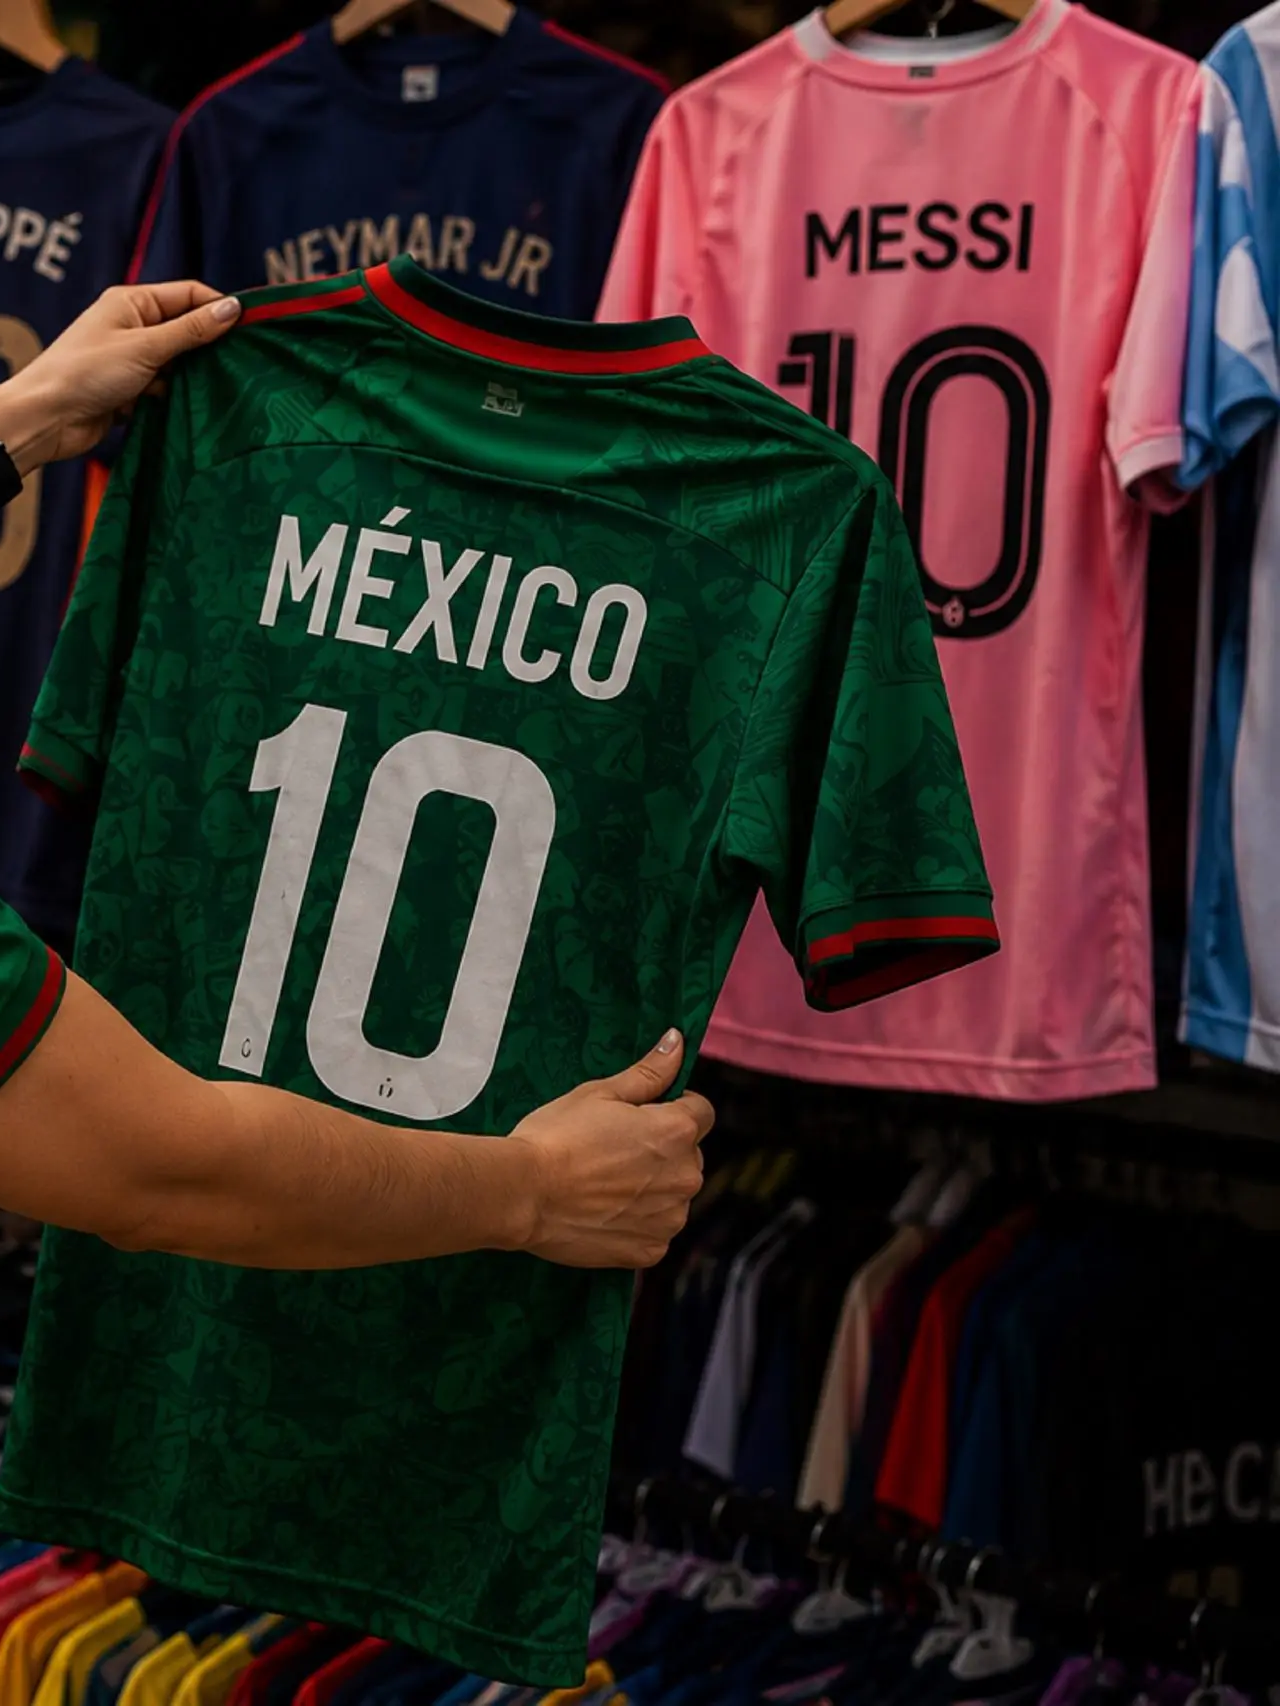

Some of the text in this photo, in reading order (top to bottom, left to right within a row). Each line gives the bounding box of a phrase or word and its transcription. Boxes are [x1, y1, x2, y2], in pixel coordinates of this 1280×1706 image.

[264, 212, 553, 297] NEYMAR JR
[806, 201, 1034, 278] MESSI
[258, 505, 648, 700] MÉXICO
[218, 702, 556, 1121] 10
